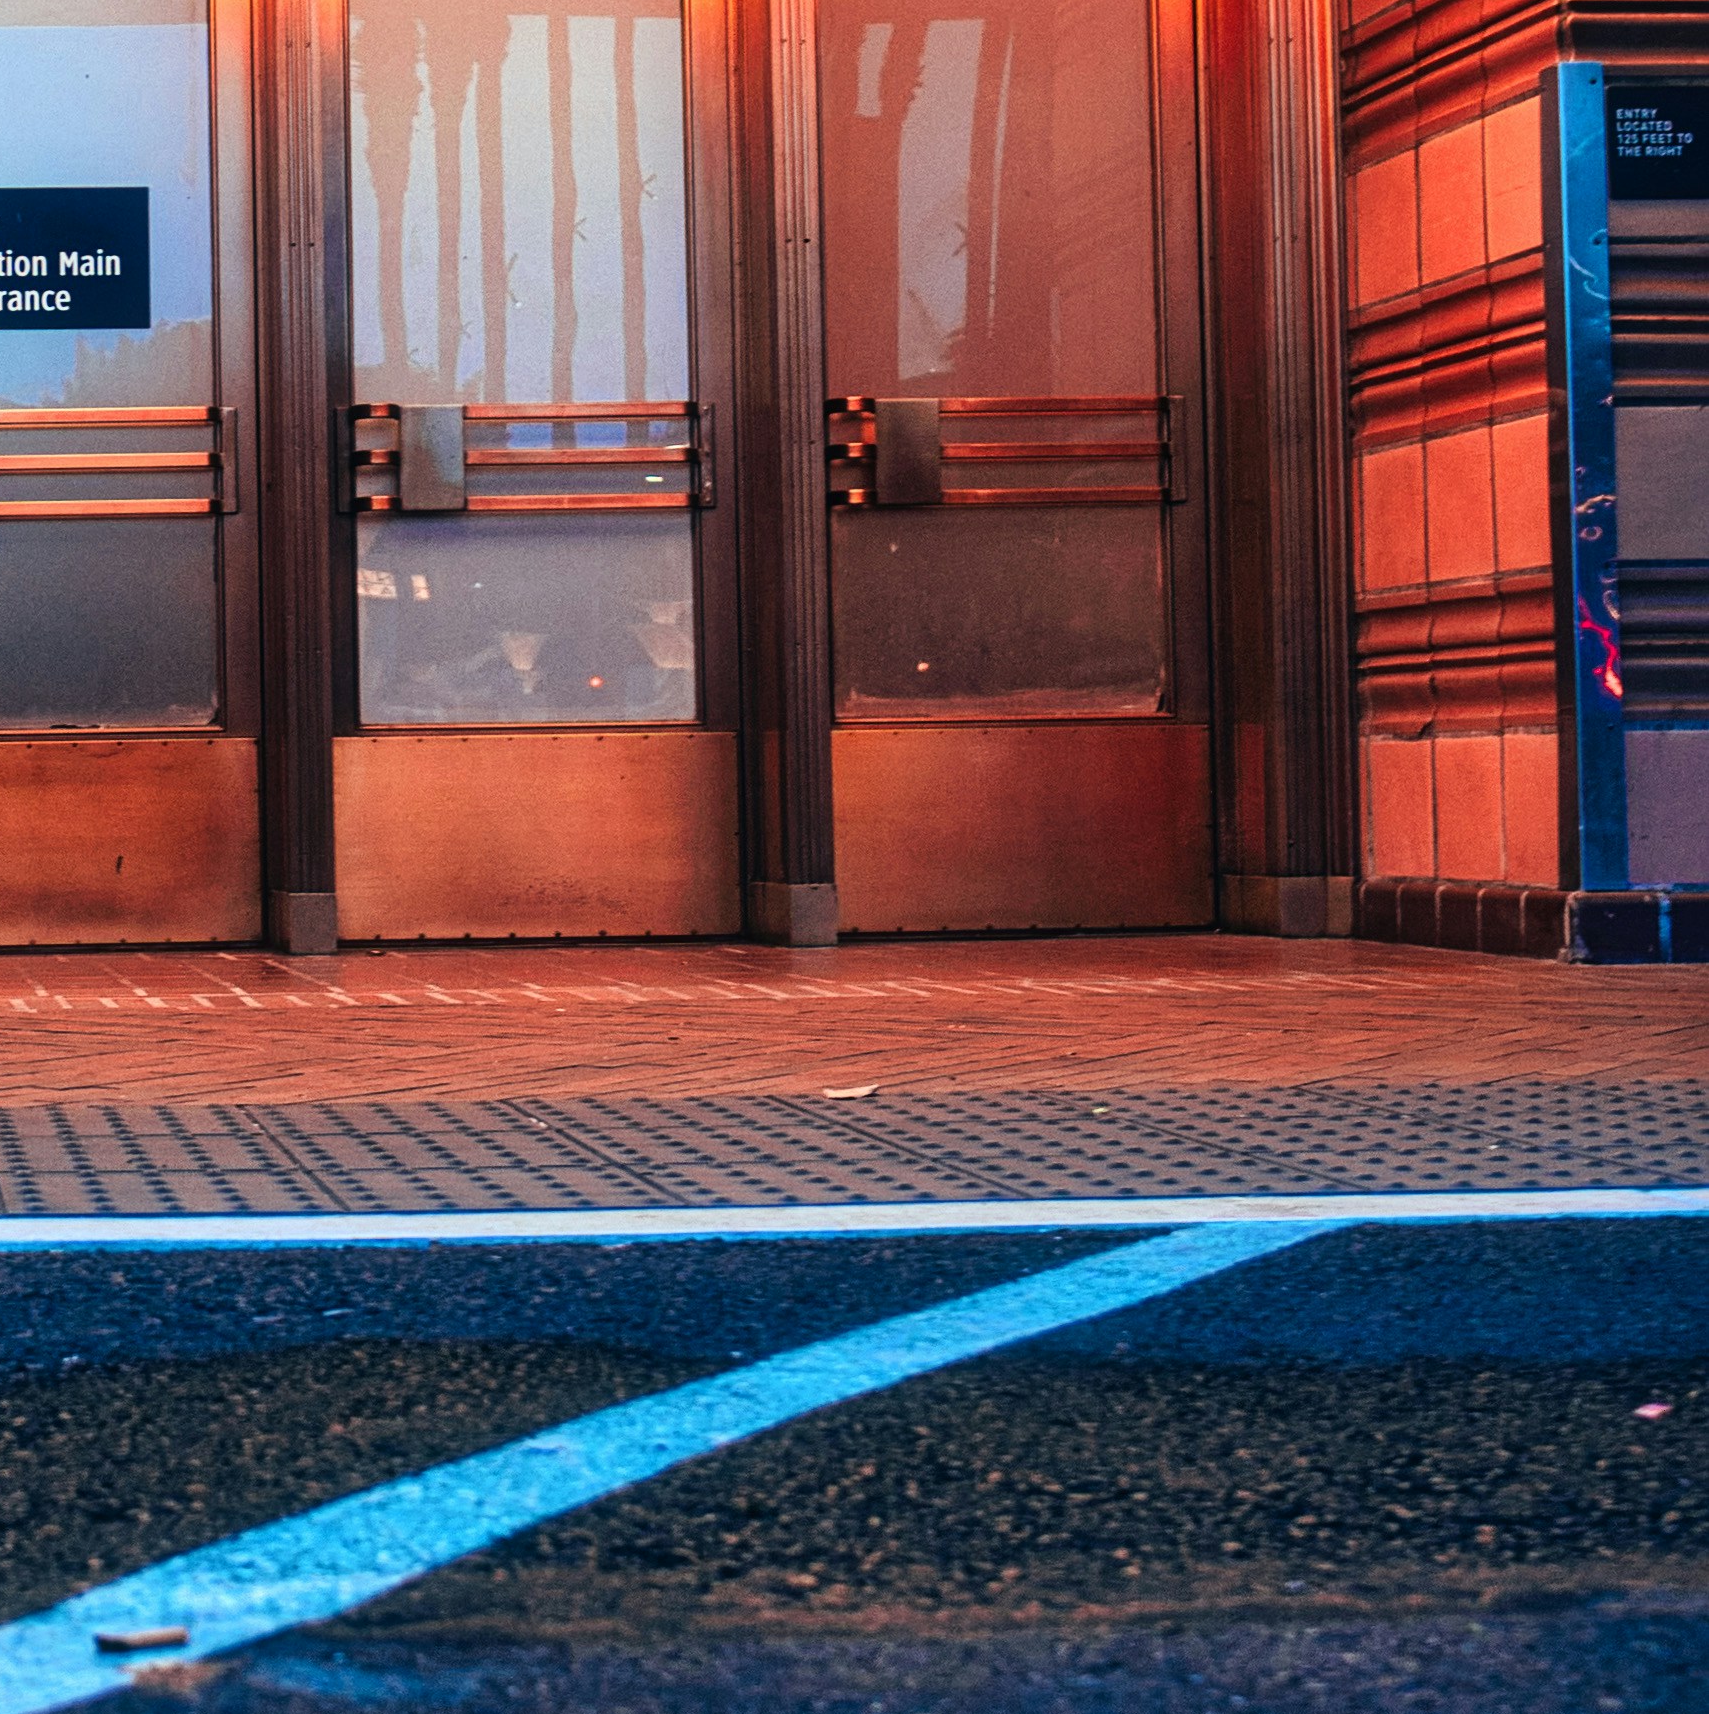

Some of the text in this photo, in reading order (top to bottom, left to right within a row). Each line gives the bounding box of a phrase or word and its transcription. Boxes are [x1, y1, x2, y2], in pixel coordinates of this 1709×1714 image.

[1616, 108, 1657, 119] ENTRY
[1616, 120, 1673, 132] LOCATED
[1617, 132, 1694, 144] 125 FEET TO
[1617, 145, 1683, 157] THE RIGHT
[59, 248, 121, 276] Main
